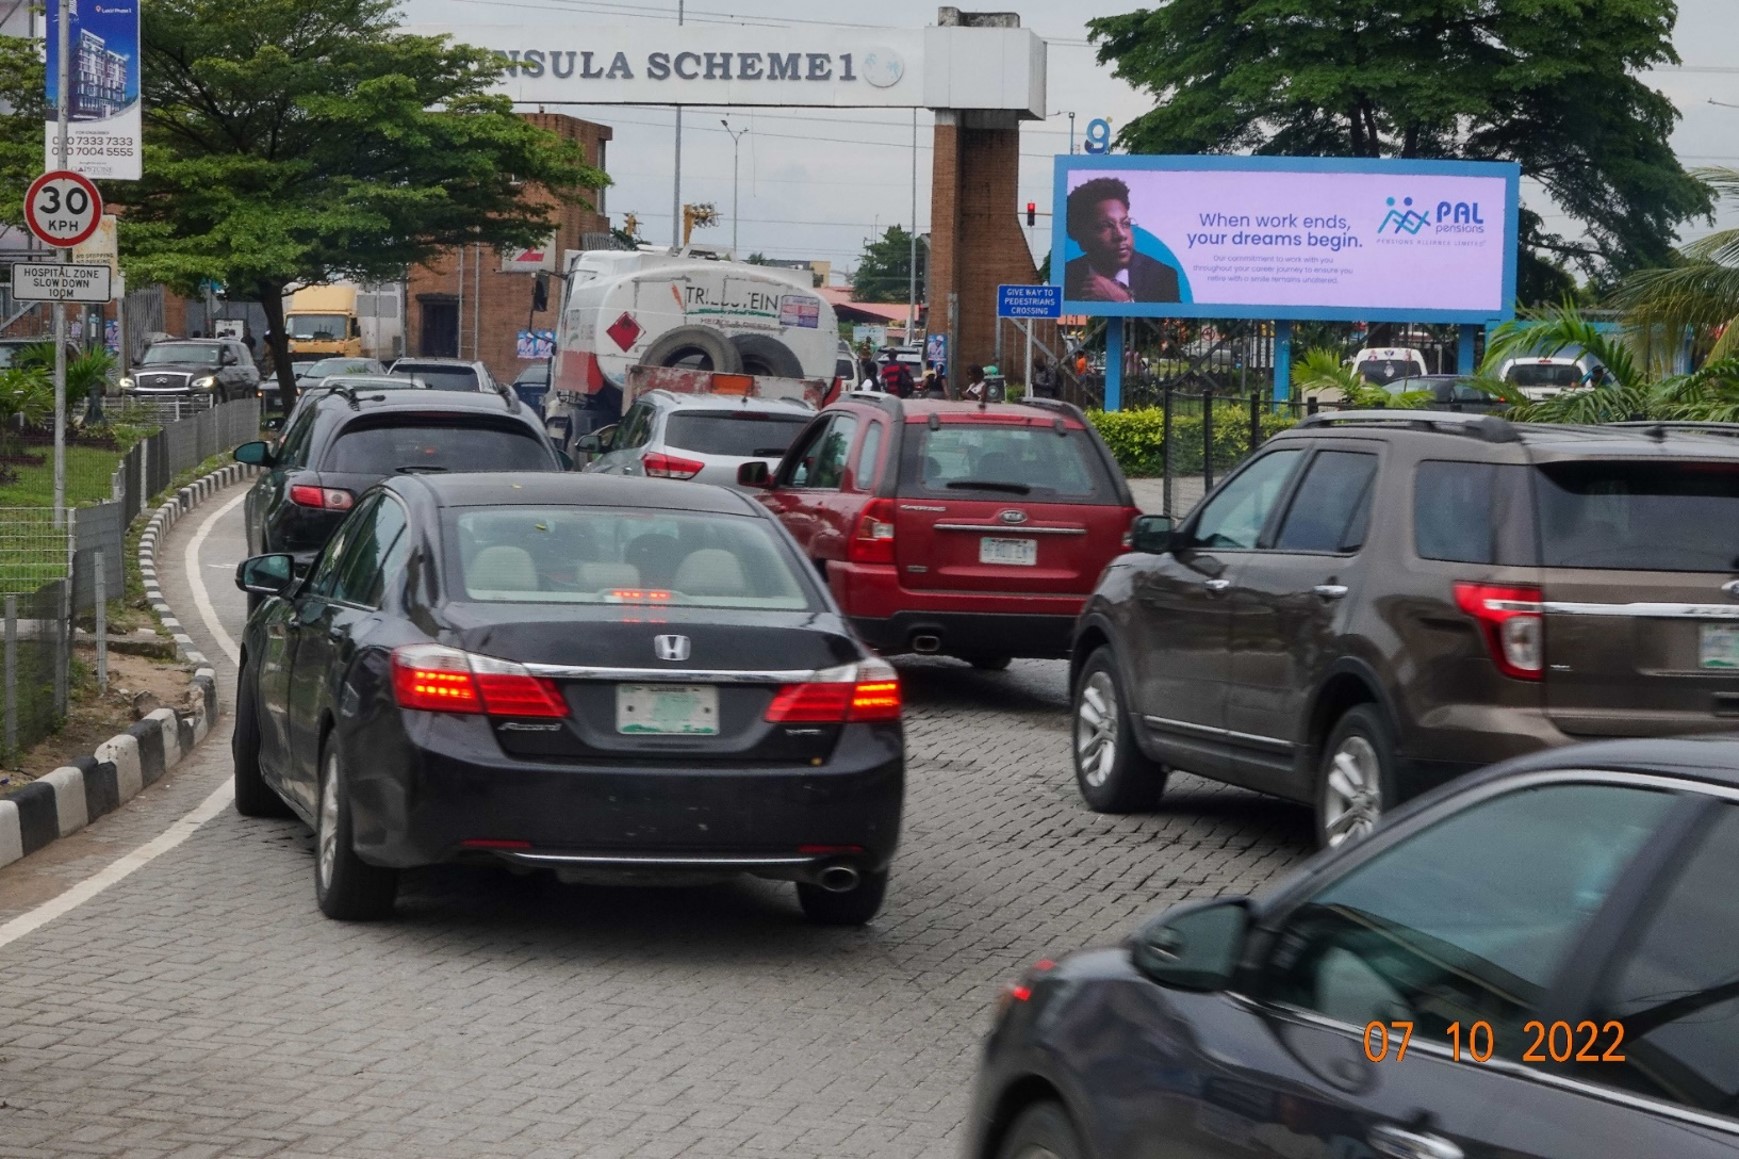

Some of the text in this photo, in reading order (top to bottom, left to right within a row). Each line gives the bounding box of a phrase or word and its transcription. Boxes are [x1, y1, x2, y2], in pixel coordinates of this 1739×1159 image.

[52, 136, 133, 147] 00 7333 7333
[51, 147, 134, 157] 00 7004 5555
[39, 186, 88, 215] 30
[1436, 201, 1484, 225] PAL
[48, 220, 79, 231] KPH
[1199, 212, 1352, 232] When work ends,
[1435, 223, 1485, 235] pensions
[1187, 230, 1364, 252] your dreams begin.
[1227, 255, 1275, 263] commitment
[1284, 255, 1302, 263] work
[1320, 257, 1334, 265] you
[24, 268, 100, 279] HOSPITAL ZONE
[33, 278, 90, 288] SLOW DOWN
[49, 289, 74, 298] 100M
[1006, 288, 1054, 297] GIVE WAY TO
[1004, 297, 1056, 306] PEDESTRIANS
[1011, 307, 1049, 315] CROSSING
